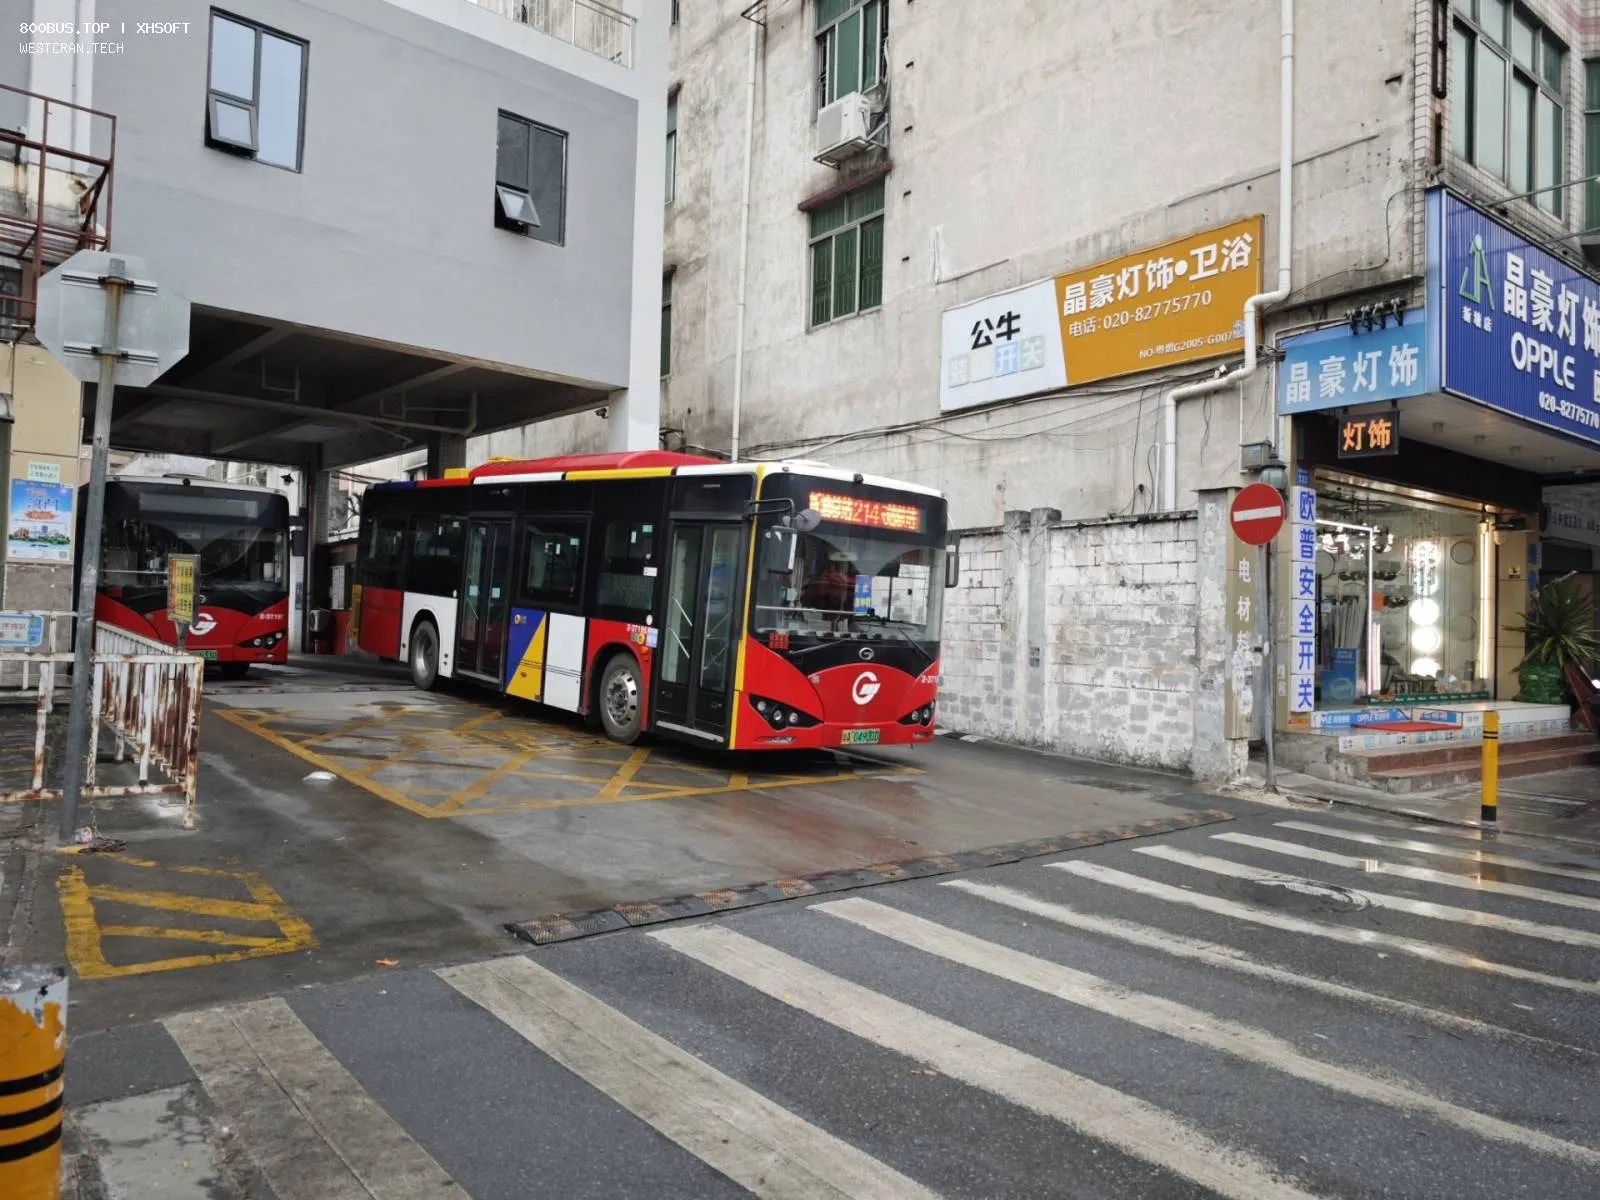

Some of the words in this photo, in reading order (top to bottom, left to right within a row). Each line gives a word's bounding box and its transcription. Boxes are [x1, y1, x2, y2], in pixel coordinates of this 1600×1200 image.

[971, 311, 1021, 350] 公牛
[1286, 343, 1419, 405] 晶豪灯饰
[1510, 331, 1576, 391] OPPLE
[1342, 418, 1392, 452] 灯饰
[852, 500, 881, 525] 214
[1298, 491, 1315, 709] 欧普安全开关
